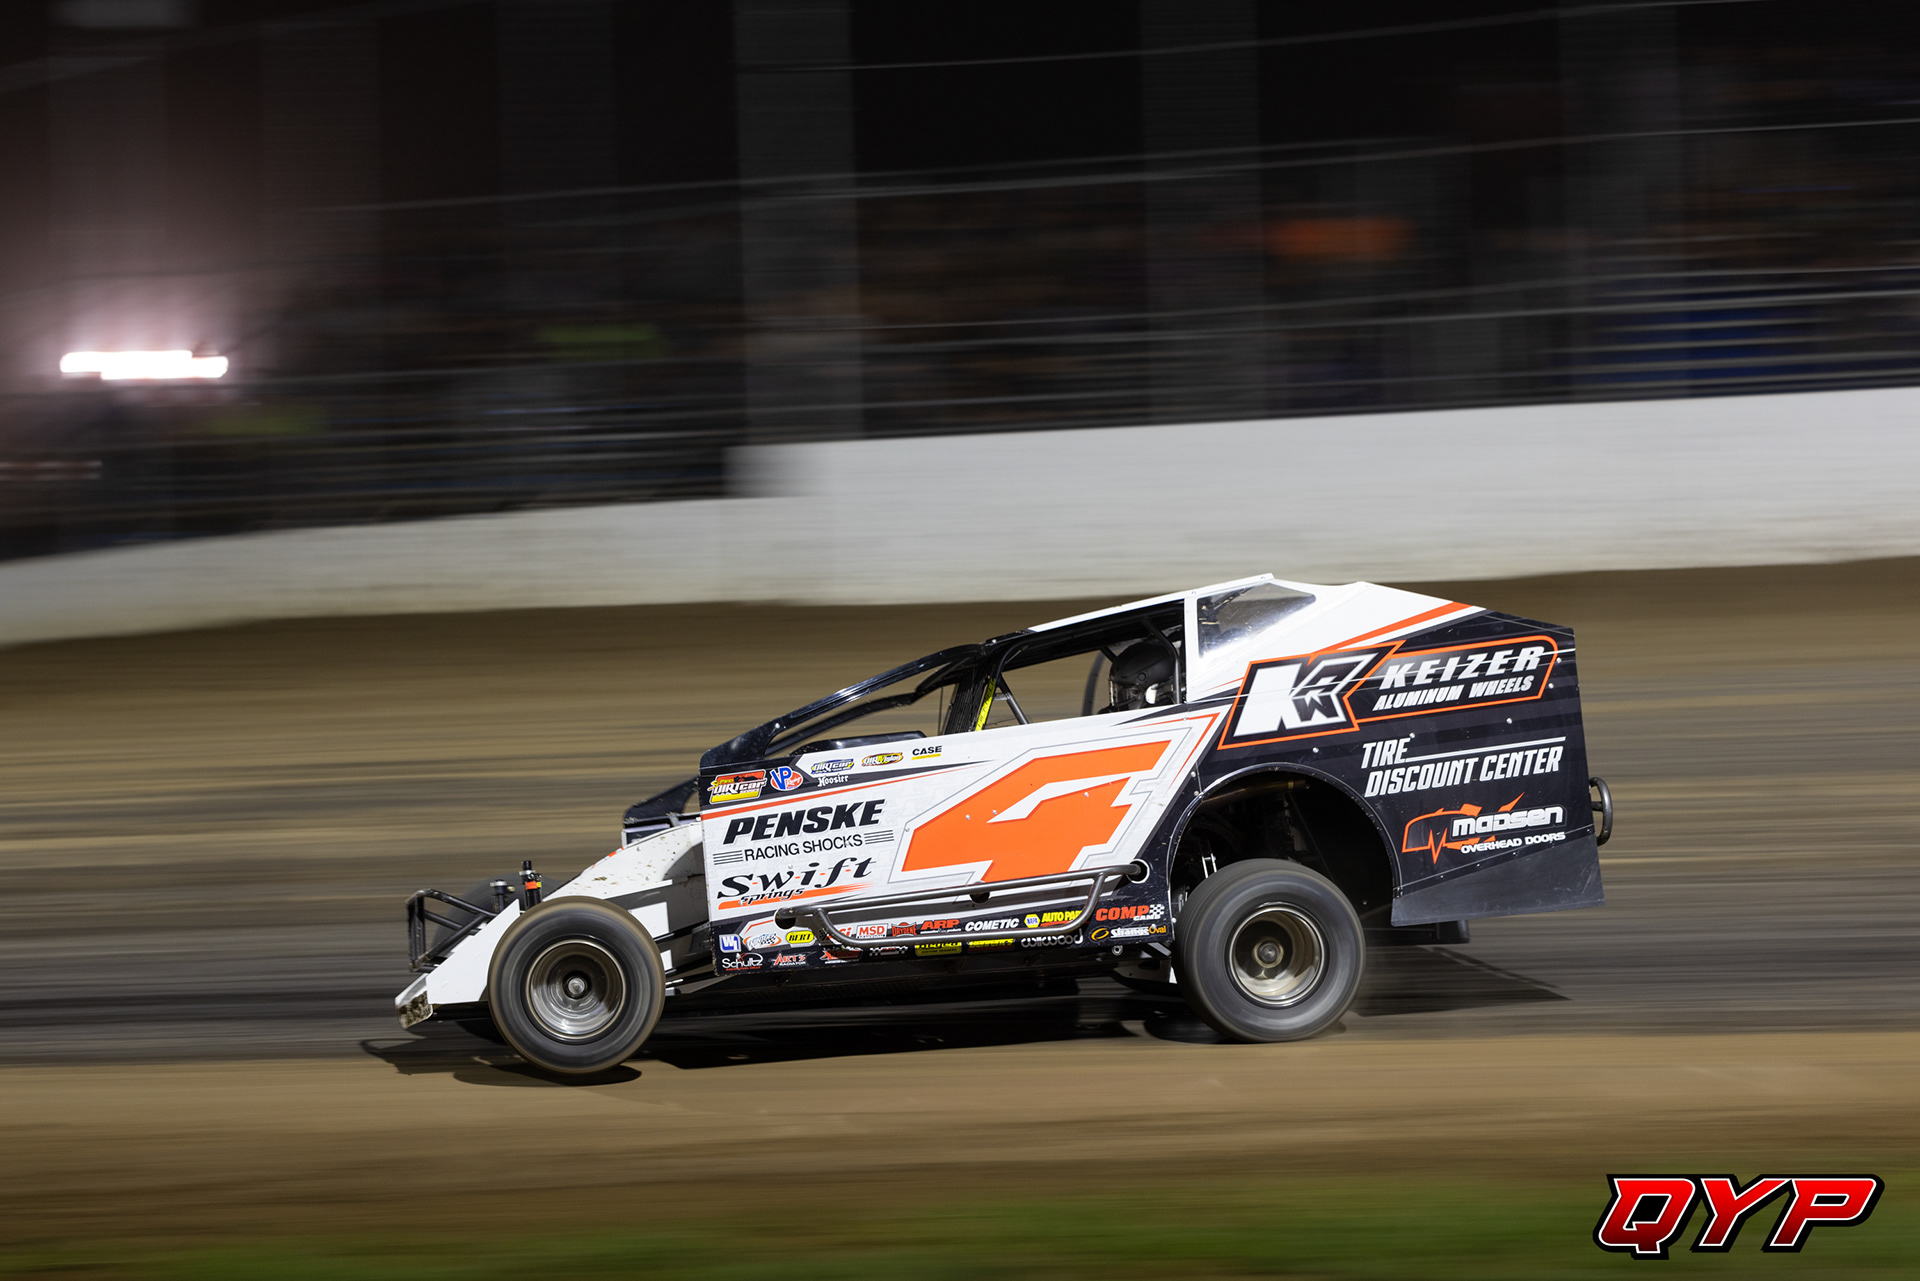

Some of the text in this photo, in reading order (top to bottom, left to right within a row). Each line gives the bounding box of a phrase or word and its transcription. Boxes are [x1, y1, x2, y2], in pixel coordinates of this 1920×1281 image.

[1378, 645, 1546, 690] KEIZER
[1372, 675, 1535, 712] ALUMINUM WHEELS
[912, 746, 942, 756] CASE
[1360, 737, 1411, 769] TIRE
[771, 767, 792, 790] VP
[817, 774, 849, 787] Hoosier
[1364, 747, 1565, 798] DISCOUNT CENTER
[901, 740, 1171, 884] 4
[723, 799, 885, 845] PENSKE
[744, 834, 863, 861] RACING SHOCKS
[1460, 832, 1566, 854] OVERHEAD DOORS
[740, 887, 804, 905] springs
[1041, 912, 1065, 923] AUTO
[1095, 905, 1150, 921] COMP
[859, 926, 885, 936] MSD
[920, 919, 960, 930] ARP
[965, 918, 1019, 932] COMETIC
[1149, 925, 1167, 935] Oval
[722, 957, 763, 969] Schultz
